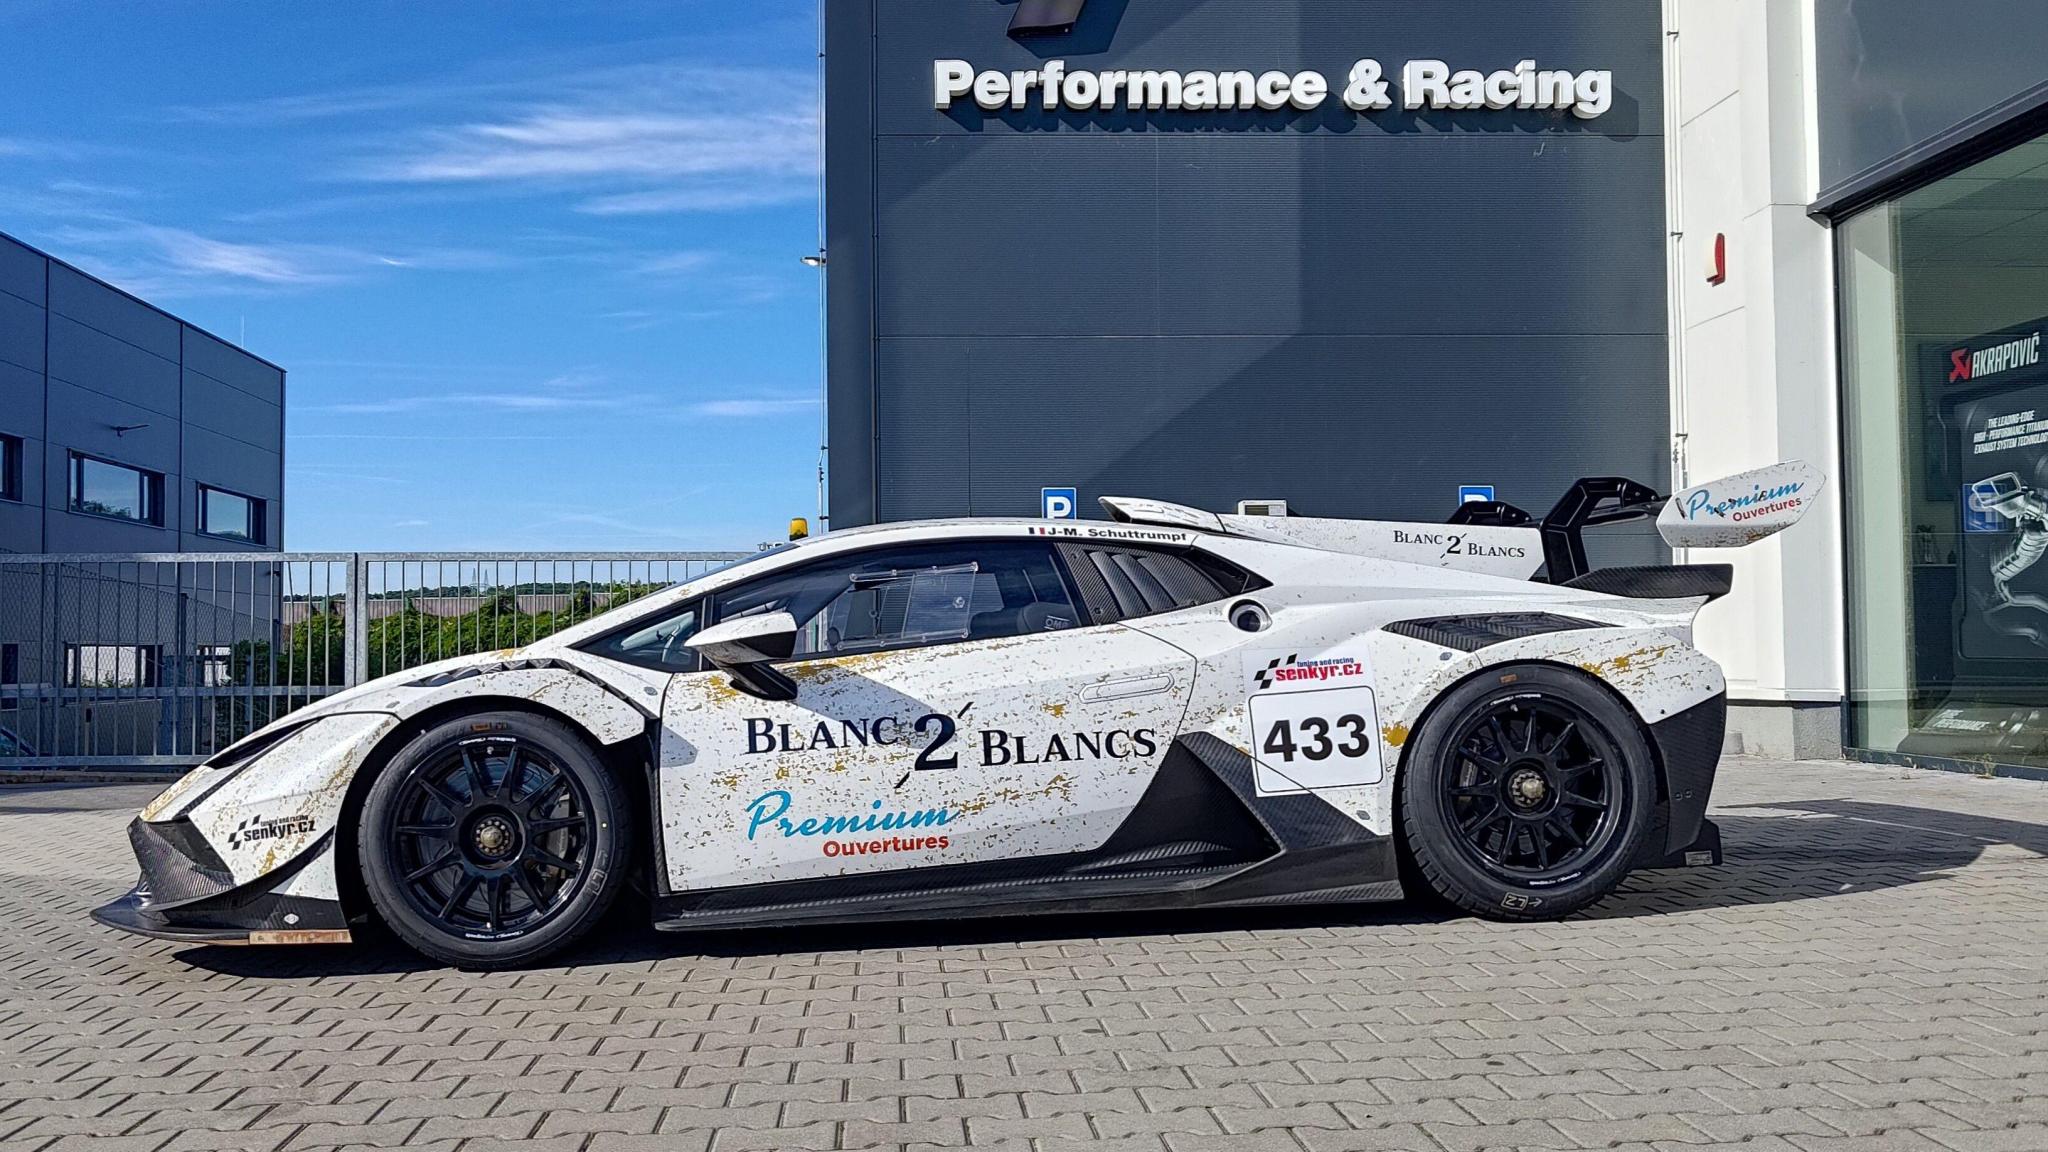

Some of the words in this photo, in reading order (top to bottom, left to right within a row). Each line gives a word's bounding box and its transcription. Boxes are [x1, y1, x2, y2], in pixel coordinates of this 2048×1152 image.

[934, 59, 1328, 110] Performance
[1344, 58, 1392, 110] &
[1403, 59, 1612, 119] Racing
[1047, 496, 1072, 519] P
[1686, 482, 1804, 520] Premium
[1733, 497, 1802, 522] Ouvertures
[1048, 527, 1083, 537] J-M.
[1088, 528, 1186, 542] Schuttrumpf
[1446, 535, 1462, 555] 2
[1275, 663, 1364, 681] senkyr.cz
[1297, 660, 1318, 668] tuning
[1320, 658, 1332, 666] and
[1333, 656, 1354, 665] racing
[743, 716, 901, 754] BLANC
[914, 713, 958, 771] 2
[978, 728, 1158, 767] BLANCS
[1263, 713, 1370, 762] 433
[746, 790, 960, 840] Premium
[244, 820, 316, 841] senkyr.cz
[823, 835, 949, 858] Ouvertures
